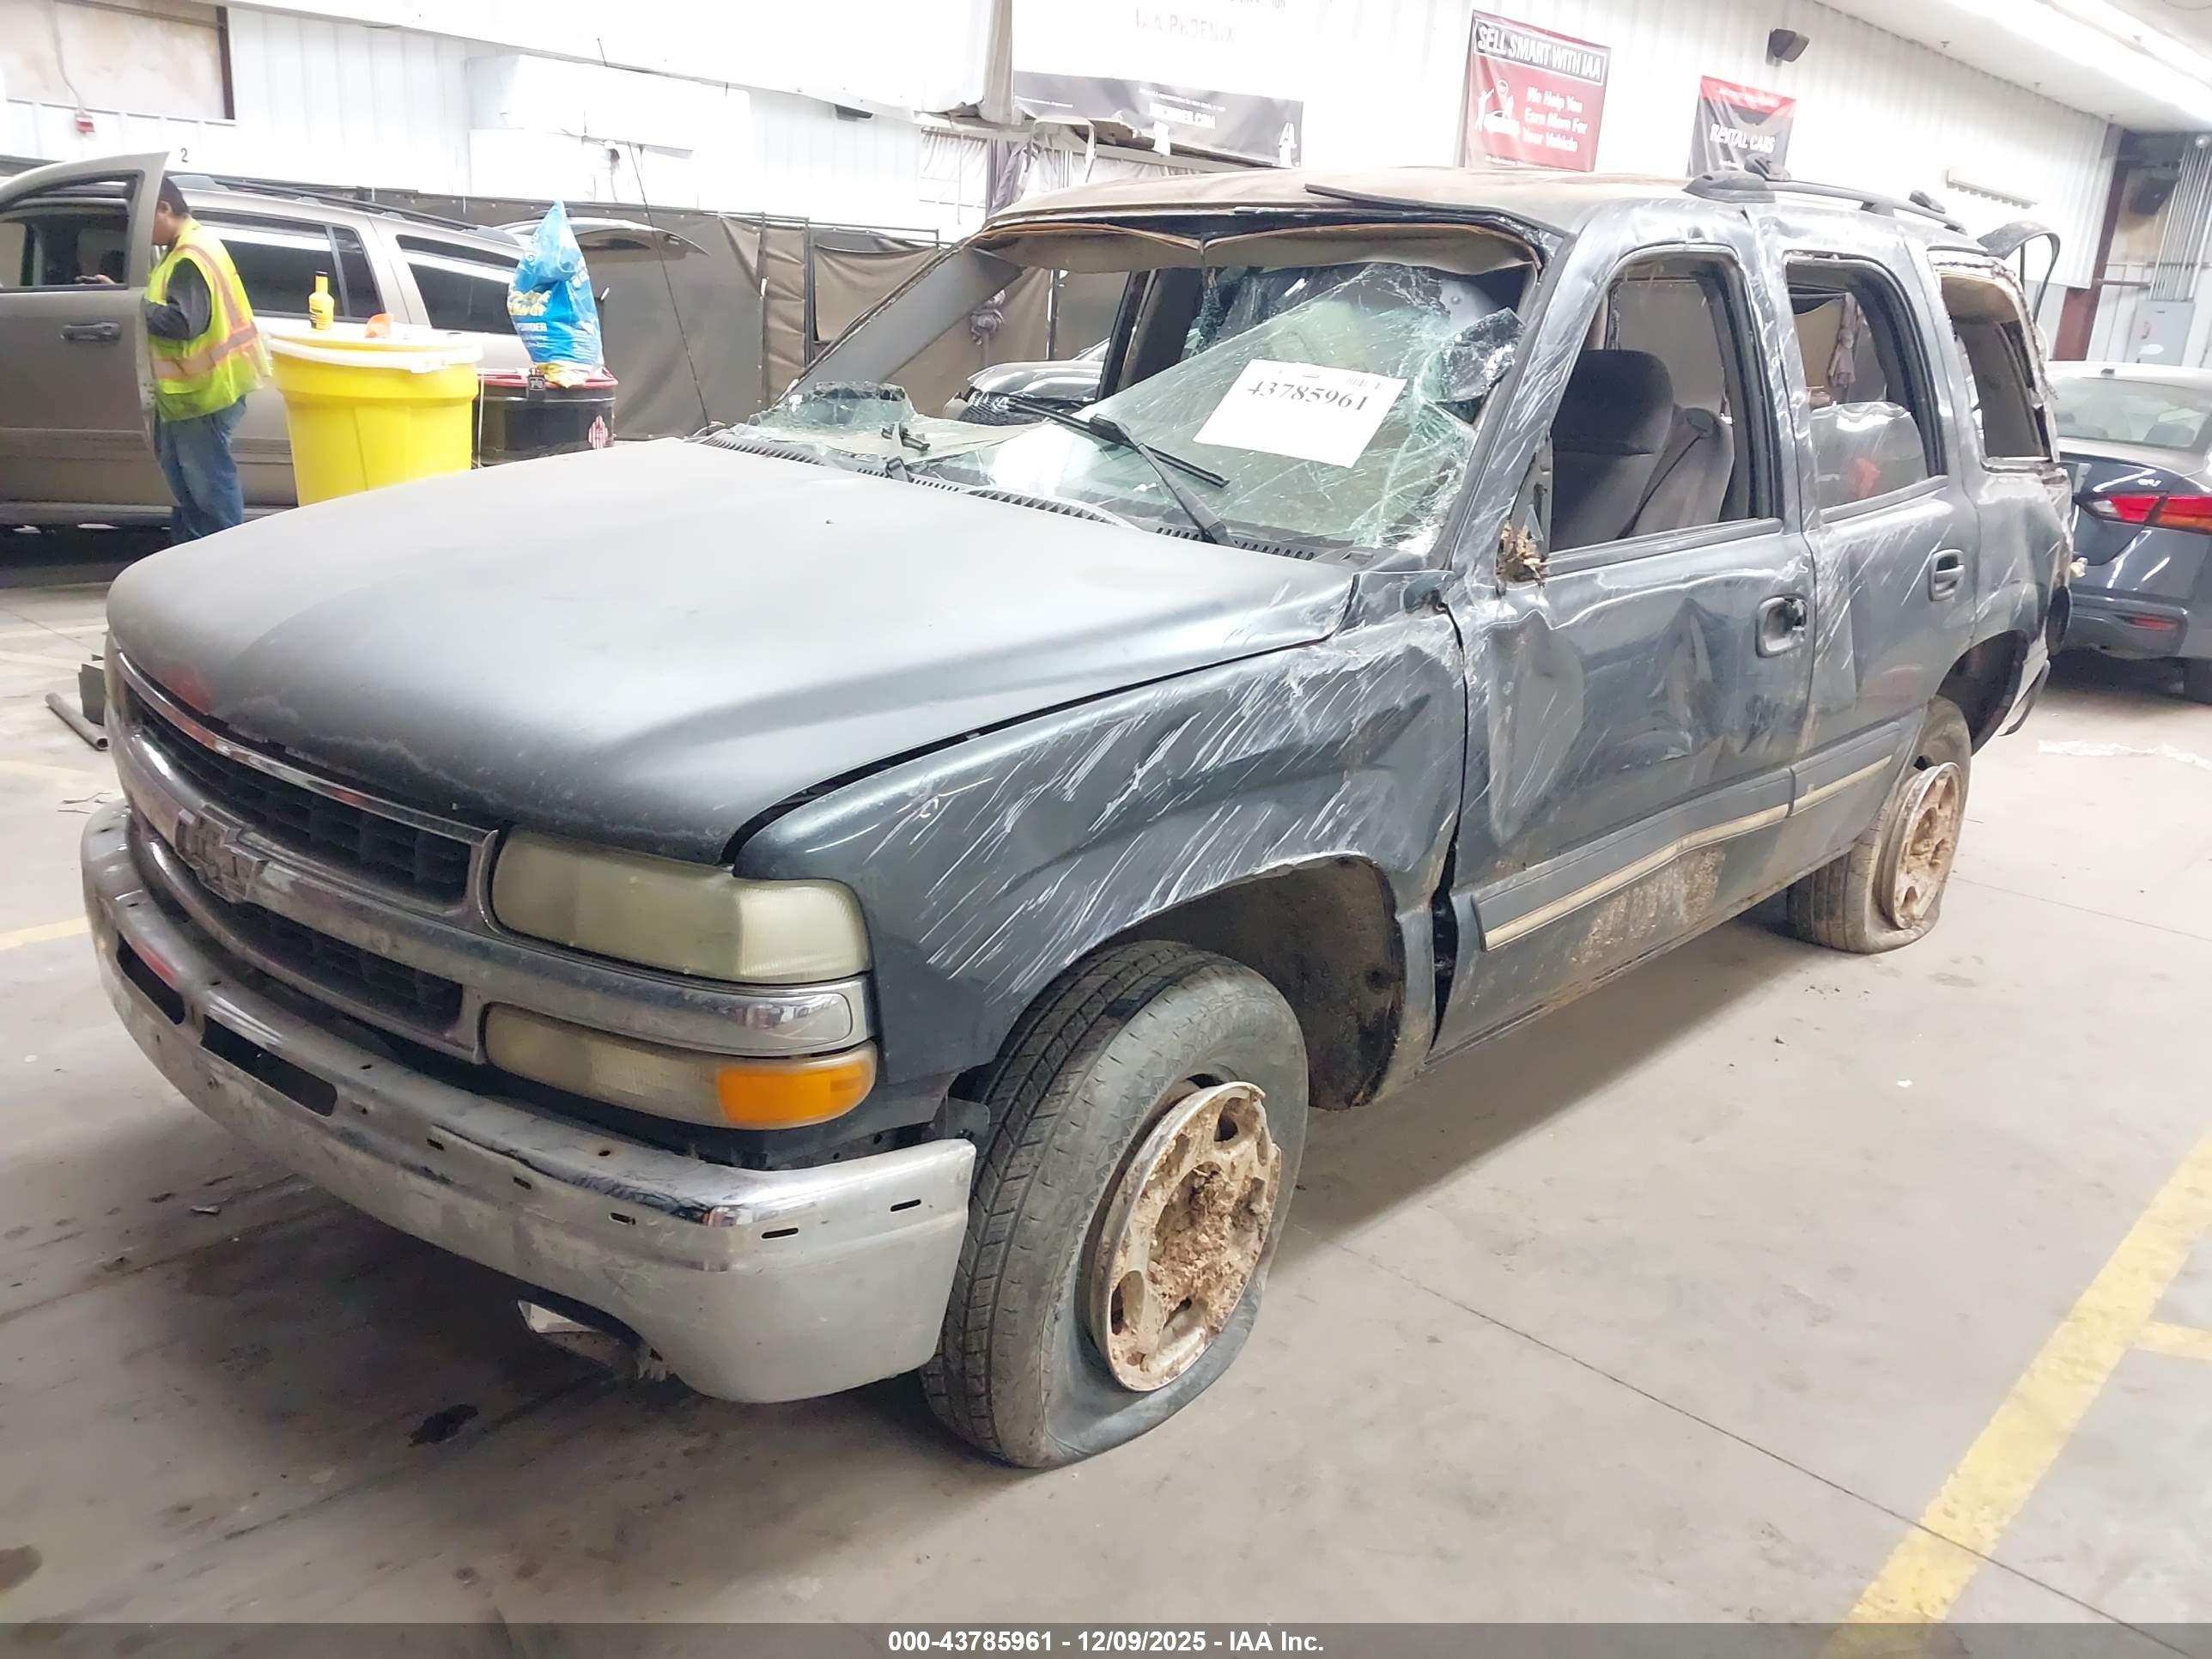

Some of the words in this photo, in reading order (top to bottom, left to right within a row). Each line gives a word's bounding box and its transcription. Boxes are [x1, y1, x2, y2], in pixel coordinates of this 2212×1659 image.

[1478, 25, 1507, 55] SELL
[1509, 34, 1552, 65] SMART
[1552, 46, 1582, 74] WITH
[1582, 54, 1601, 79] IAA
[1543, 91, 1565, 110] Help
[1710, 124, 1747, 149] RENTAL
[180, 147, 189, 163] 2
[1247, 380, 1369, 410] 43785961
